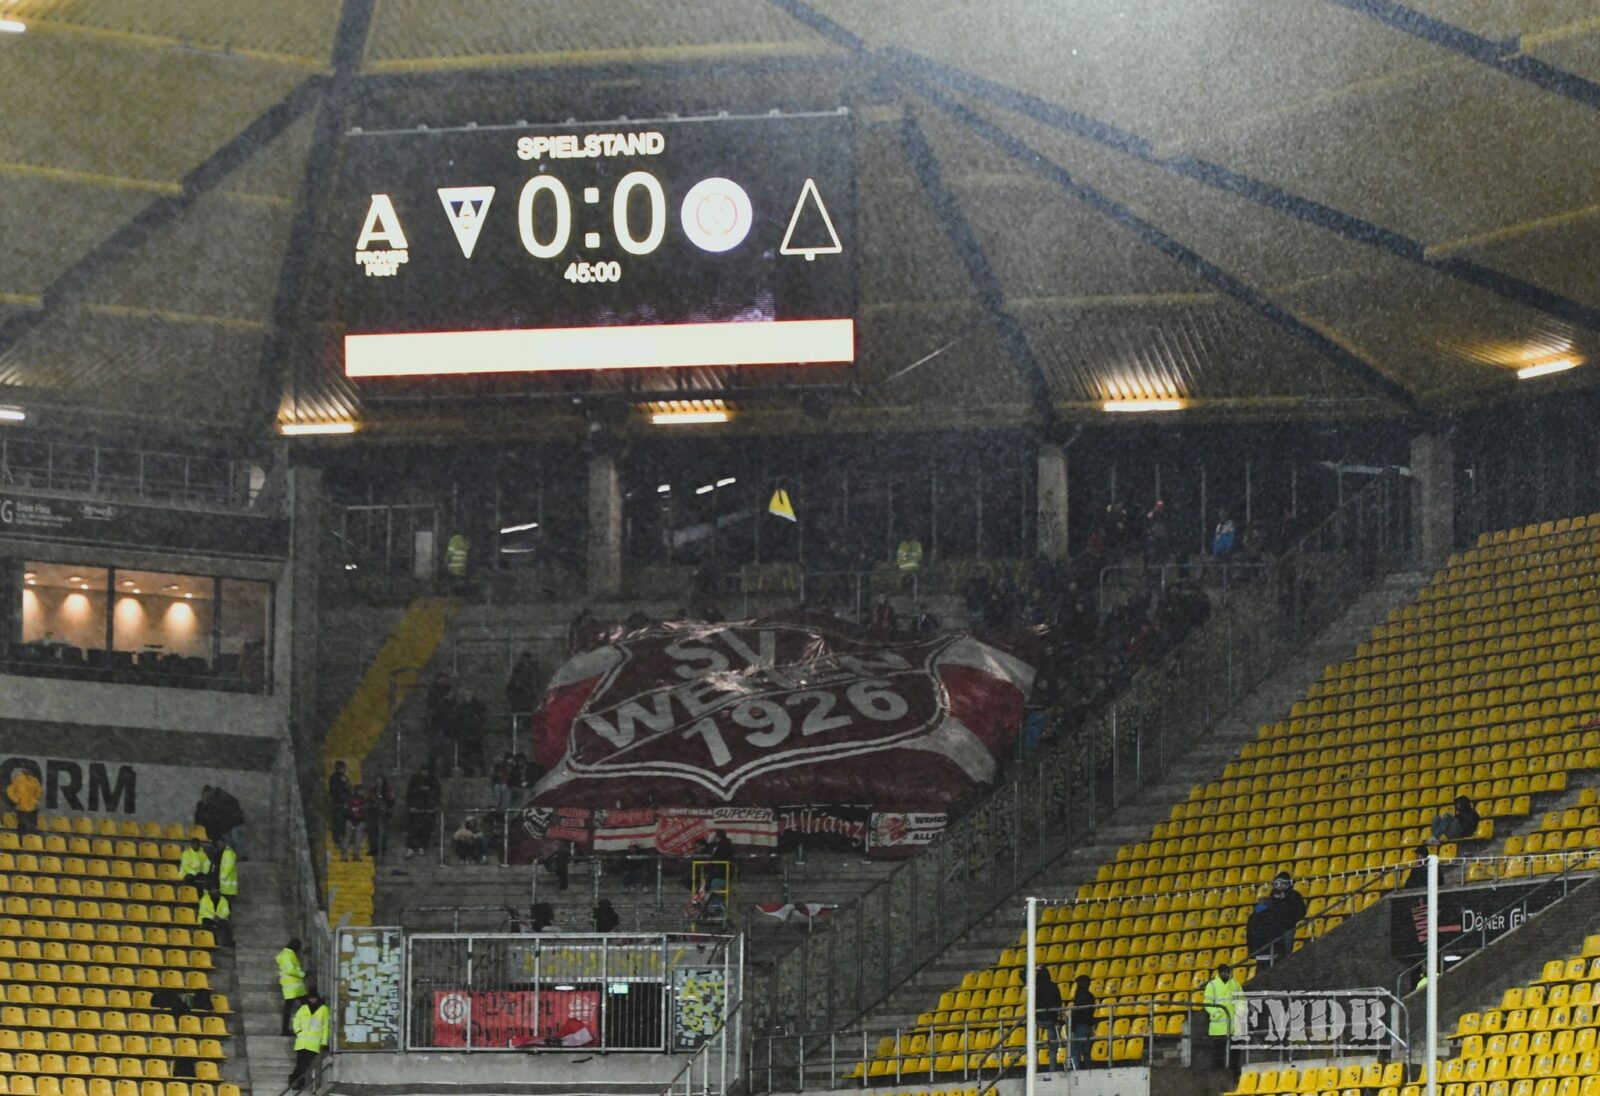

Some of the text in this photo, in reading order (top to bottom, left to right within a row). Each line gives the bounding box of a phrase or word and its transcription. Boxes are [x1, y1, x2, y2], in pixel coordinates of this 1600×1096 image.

[517, 132, 665, 160] SPIELSTAND
[564, 261, 621, 283] 45:00
[682, 680, 908, 767] 1926
